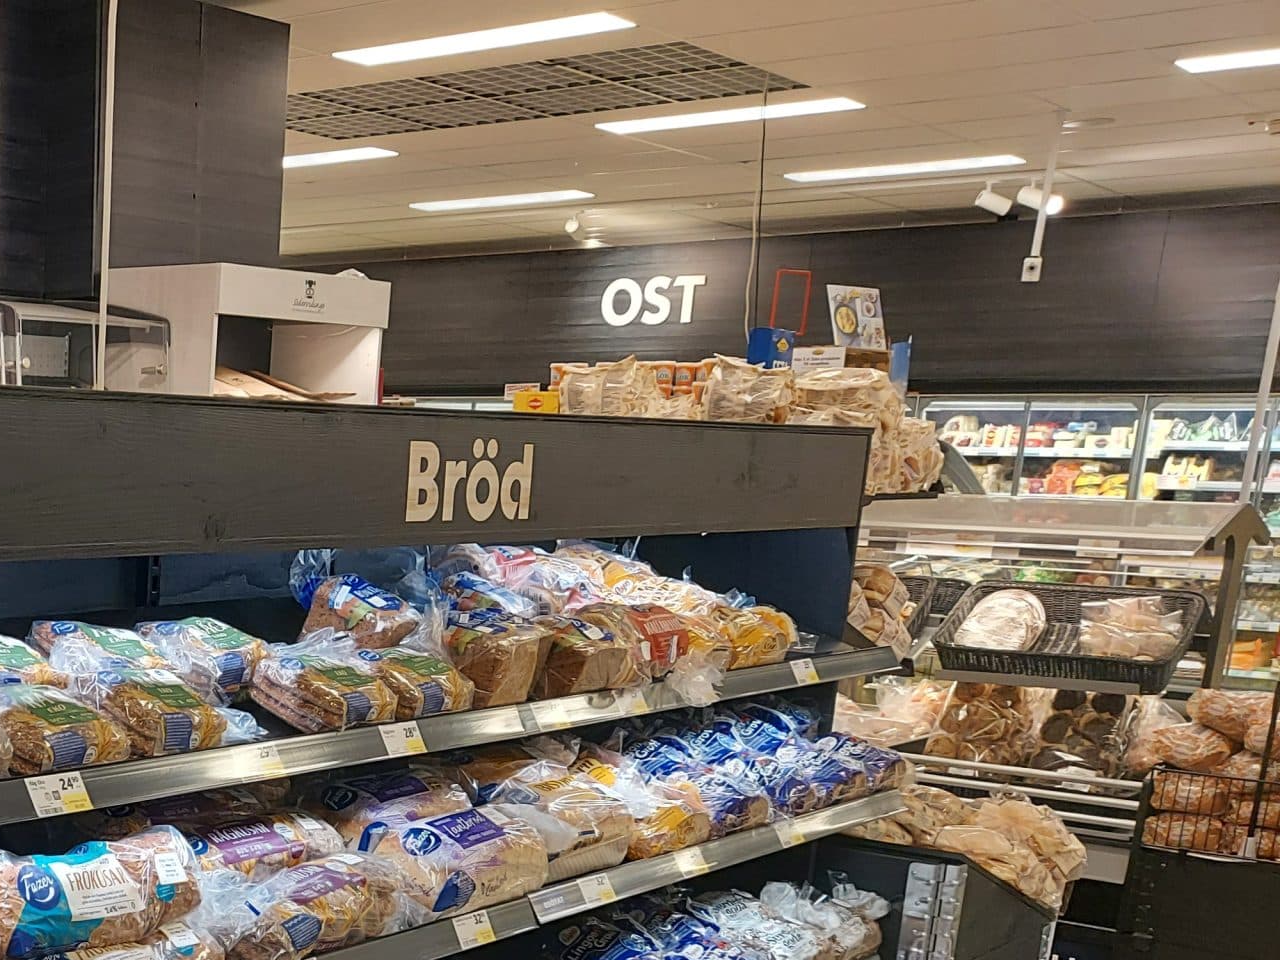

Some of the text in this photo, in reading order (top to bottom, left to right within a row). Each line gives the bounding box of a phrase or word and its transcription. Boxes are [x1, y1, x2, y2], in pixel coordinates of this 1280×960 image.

[600, 275, 707, 327] OST
[404, 437, 535, 523] Bröd
[20, 871, 54, 901] Fazer
